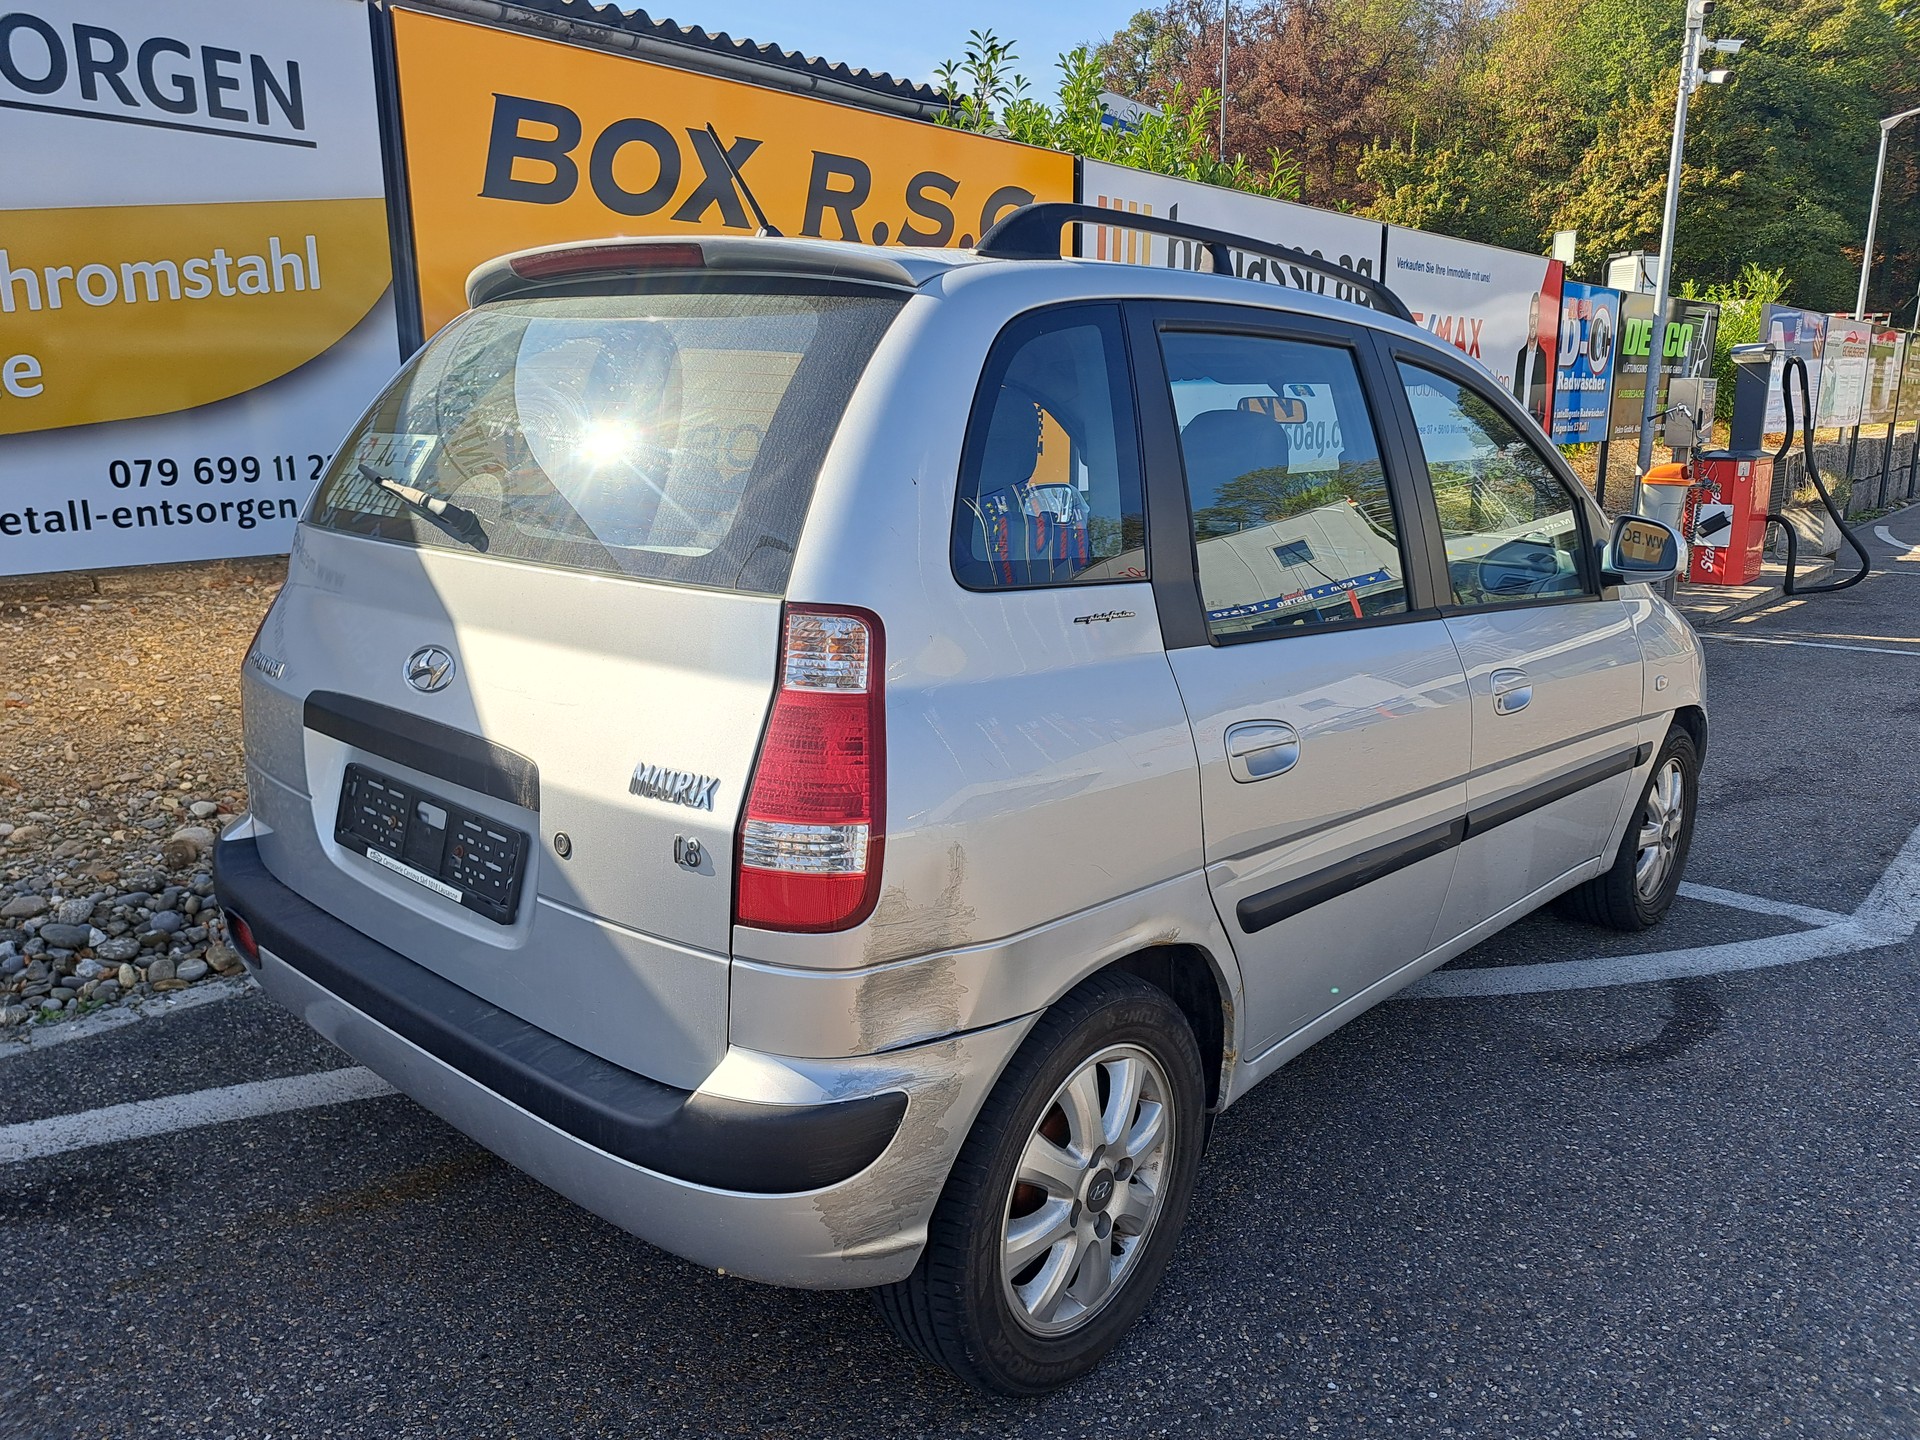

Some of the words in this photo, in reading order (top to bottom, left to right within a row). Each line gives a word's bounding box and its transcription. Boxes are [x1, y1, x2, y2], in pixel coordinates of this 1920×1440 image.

[477, 92, 764, 230] BOX
[1396, 257, 1425, 272] Verkaufen
[1425, 262, 1435, 274] Sie
[1435, 264, 1446, 276] Ihre
[1446, 266, 1471, 280] Immobilie
[1471, 271, 1480, 282] mit
[1622, 317, 1694, 358] DECO
[1557, 371, 1606, 390] Radwäscher
[109, 459, 179, 488] 079
[194, 456, 261, 485] 699
[273, 455, 297, 482] 11
[308, 454, 331, 481] 2
[0, 498, 298, 529] etall-entsorgen
[629, 762, 720, 812] MATRIX
